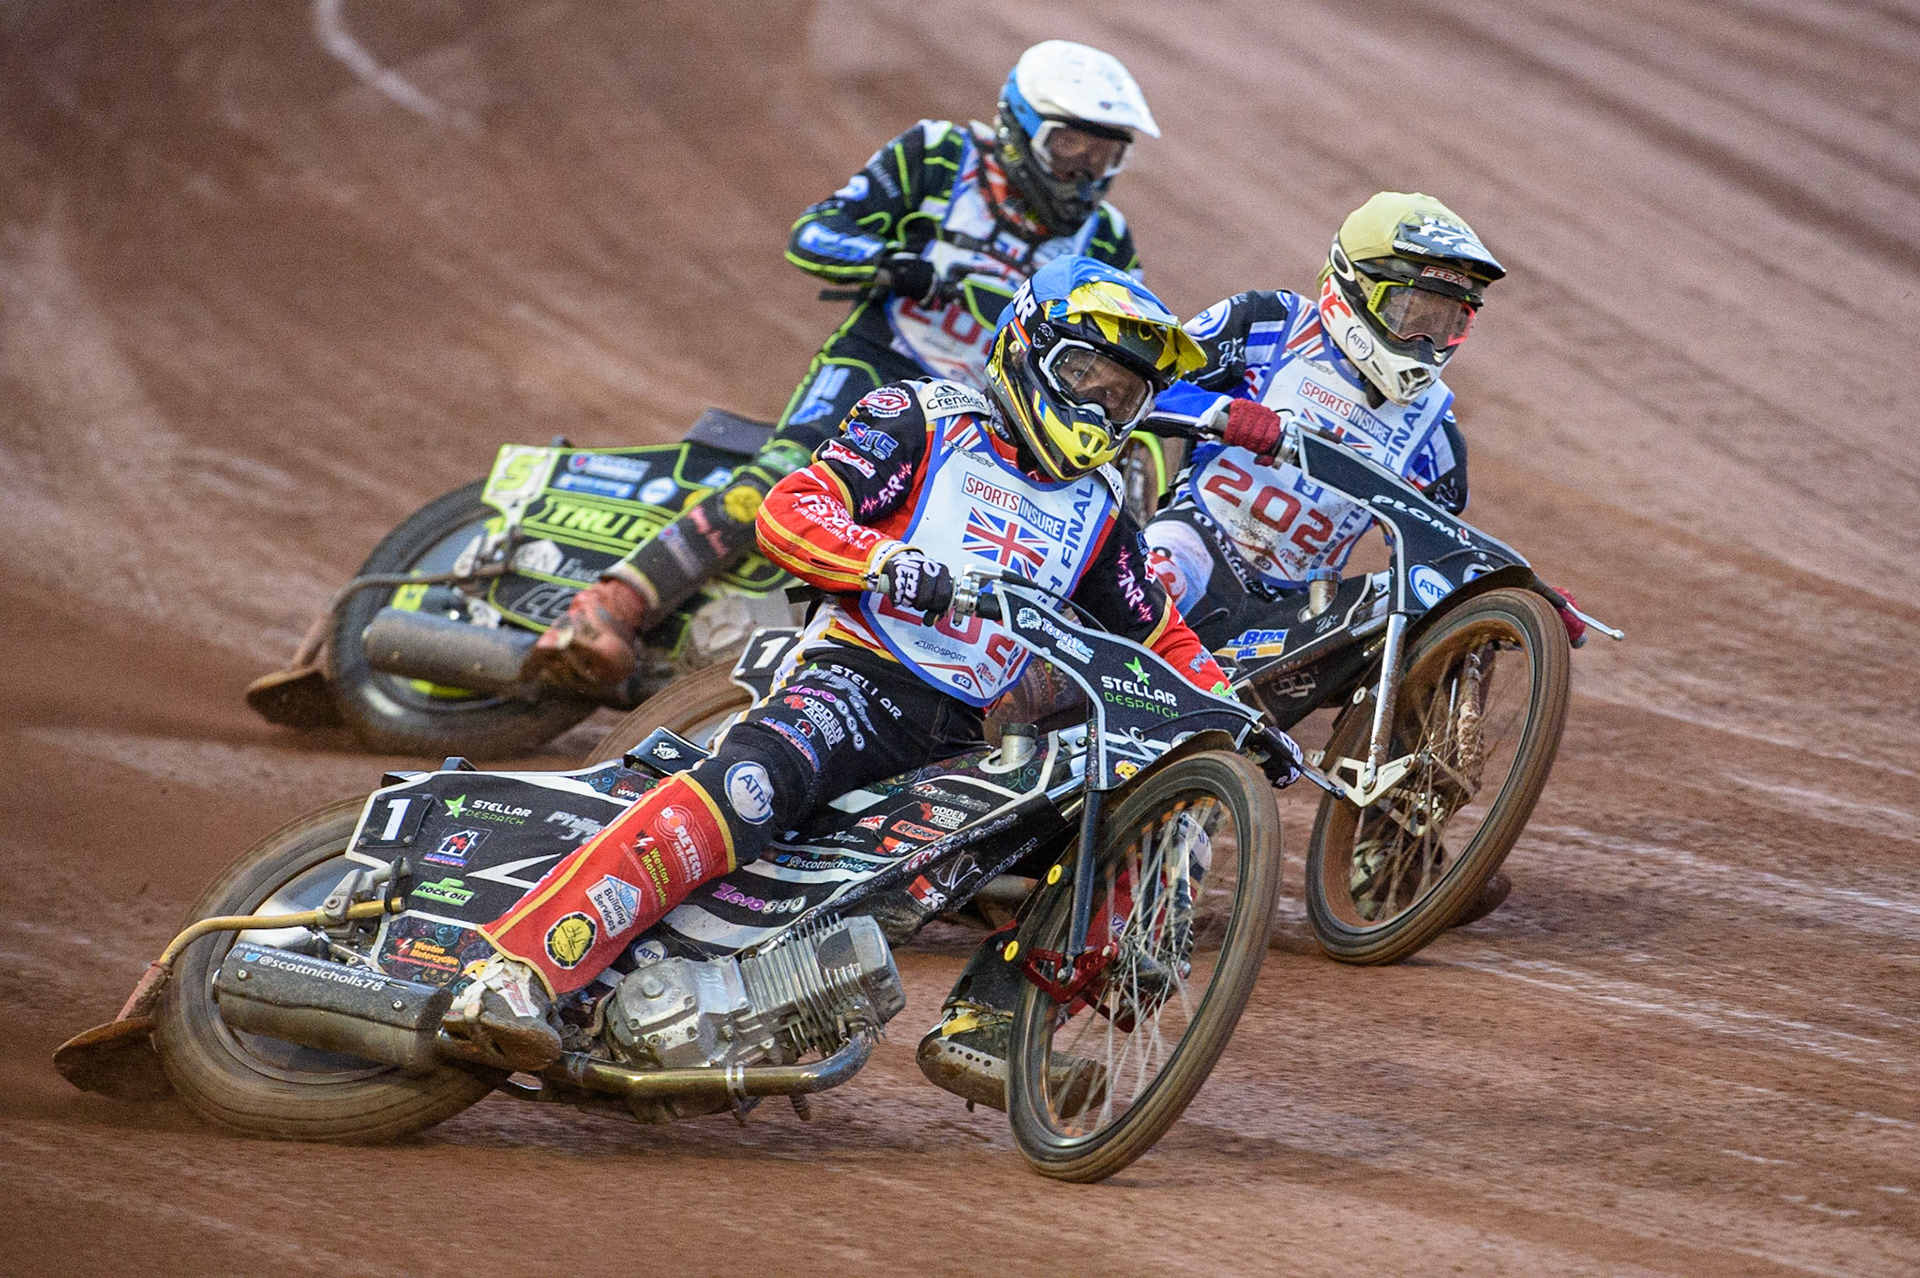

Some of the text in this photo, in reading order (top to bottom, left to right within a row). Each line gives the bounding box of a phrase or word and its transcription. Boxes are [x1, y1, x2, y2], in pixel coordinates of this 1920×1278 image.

[1350, 333, 1369, 354] ATPI
[1302, 381, 1391, 443] SPORTS INSURE
[965, 477, 1063, 538] SPORTS INSURE
[1061, 483, 1094, 569] FINAL
[1419, 579, 1446, 599] ATP
[753, 636, 791, 669] 1
[916, 640, 967, 663] EUROSPORT
[1101, 675, 1177, 707] STELLAR
[1104, 691, 1179, 719] DESPATCH
[472, 800, 533, 818] STELLAR
[738, 774, 770, 812] ATPI
[381, 798, 412, 841] 1
[465, 809, 525, 826] DESPATCH
[650, 847, 670, 884] Weston
[417, 885, 469, 902] ROCK OIL
[603, 888, 626, 925] Building
[594, 893, 616, 931] Services
[240, 942, 392, 982] www.nichollsracing.com
[414, 941, 445, 955] Weston
[637, 947, 660, 960] ATPI
[259, 955, 384, 992] @scottnicholls78
